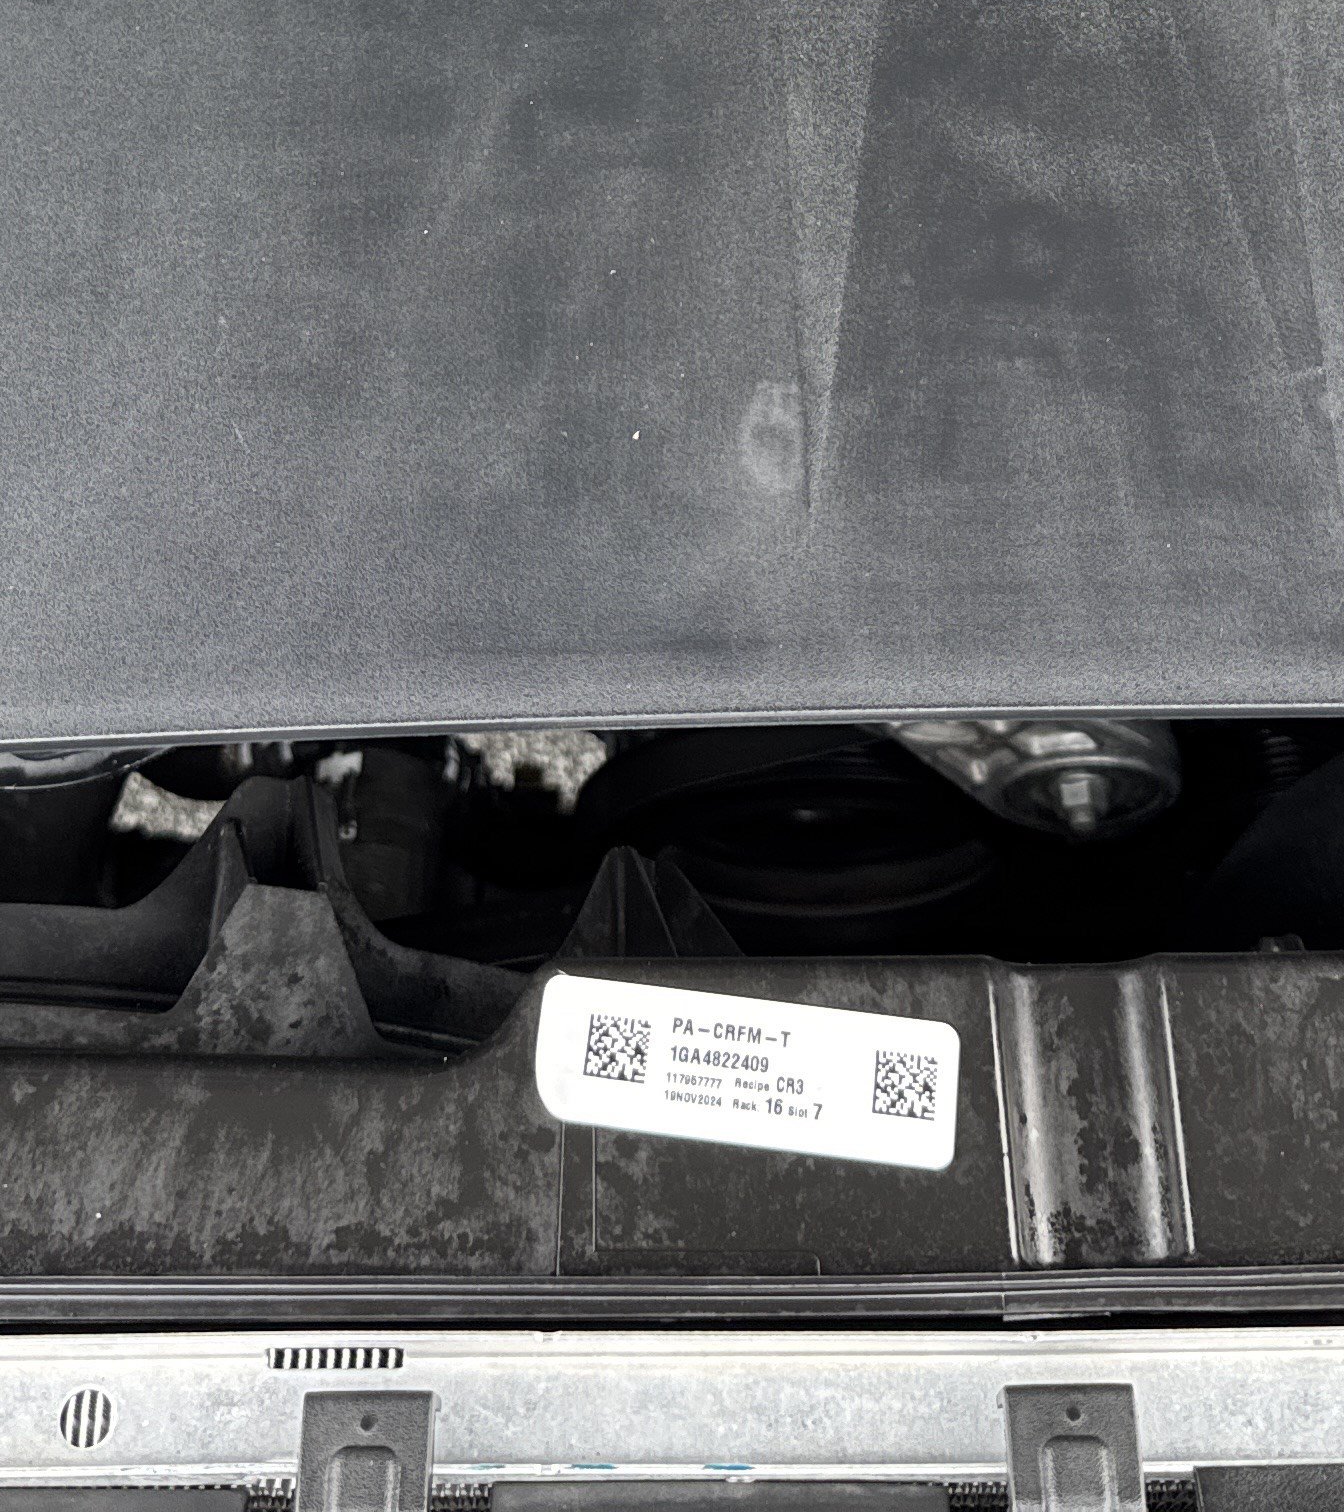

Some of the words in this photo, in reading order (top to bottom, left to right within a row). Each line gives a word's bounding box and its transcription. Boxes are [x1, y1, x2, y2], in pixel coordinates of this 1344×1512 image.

[670, 1045, 769, 1073] 1GA4822409
[734, 1077, 770, 1092] Recipe
[776, 1076, 804, 1095] CR3
[765, 1097, 783, 1115] 16
[813, 1102, 823, 1120] 7
